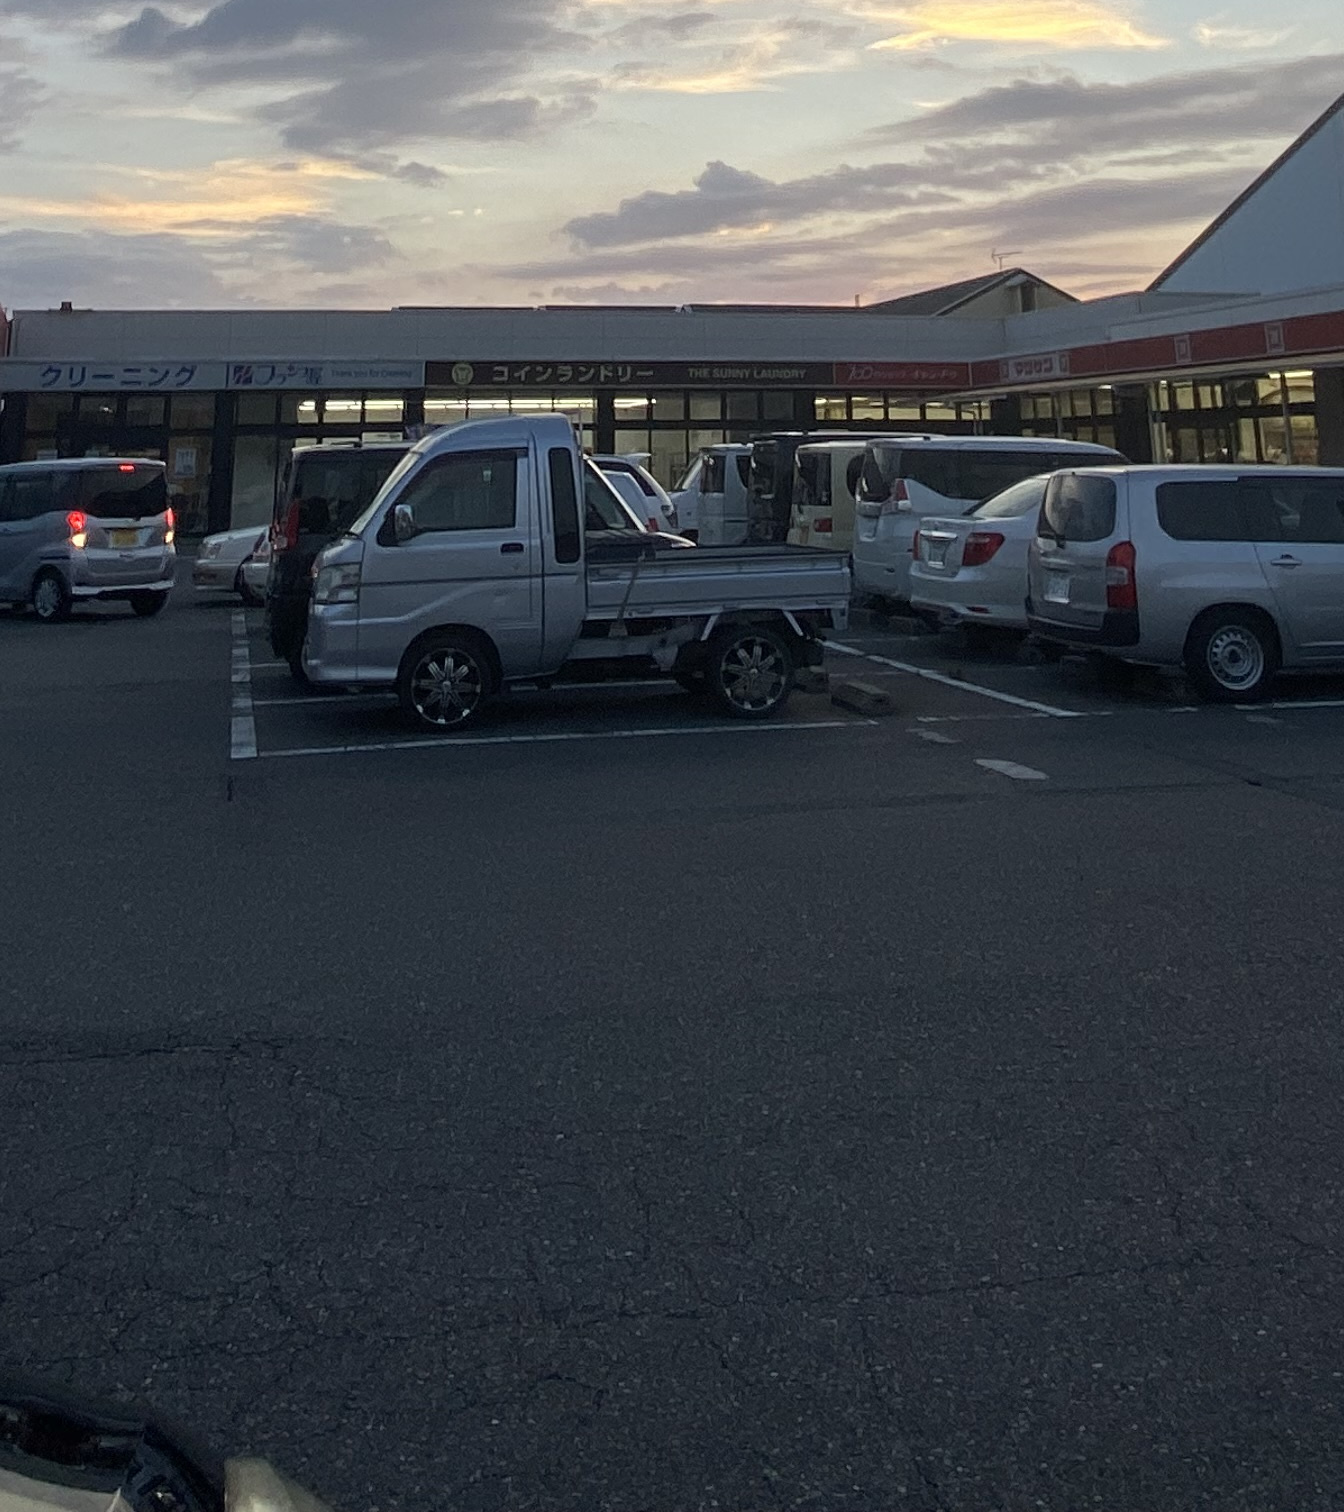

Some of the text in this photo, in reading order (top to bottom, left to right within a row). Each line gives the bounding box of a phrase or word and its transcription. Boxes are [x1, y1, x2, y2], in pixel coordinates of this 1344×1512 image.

[40, 363, 198, 388] クリーニング
[492, 365, 655, 383] コインランドリー
[688, 366, 807, 379] THE SUNNY LAUNDRY
